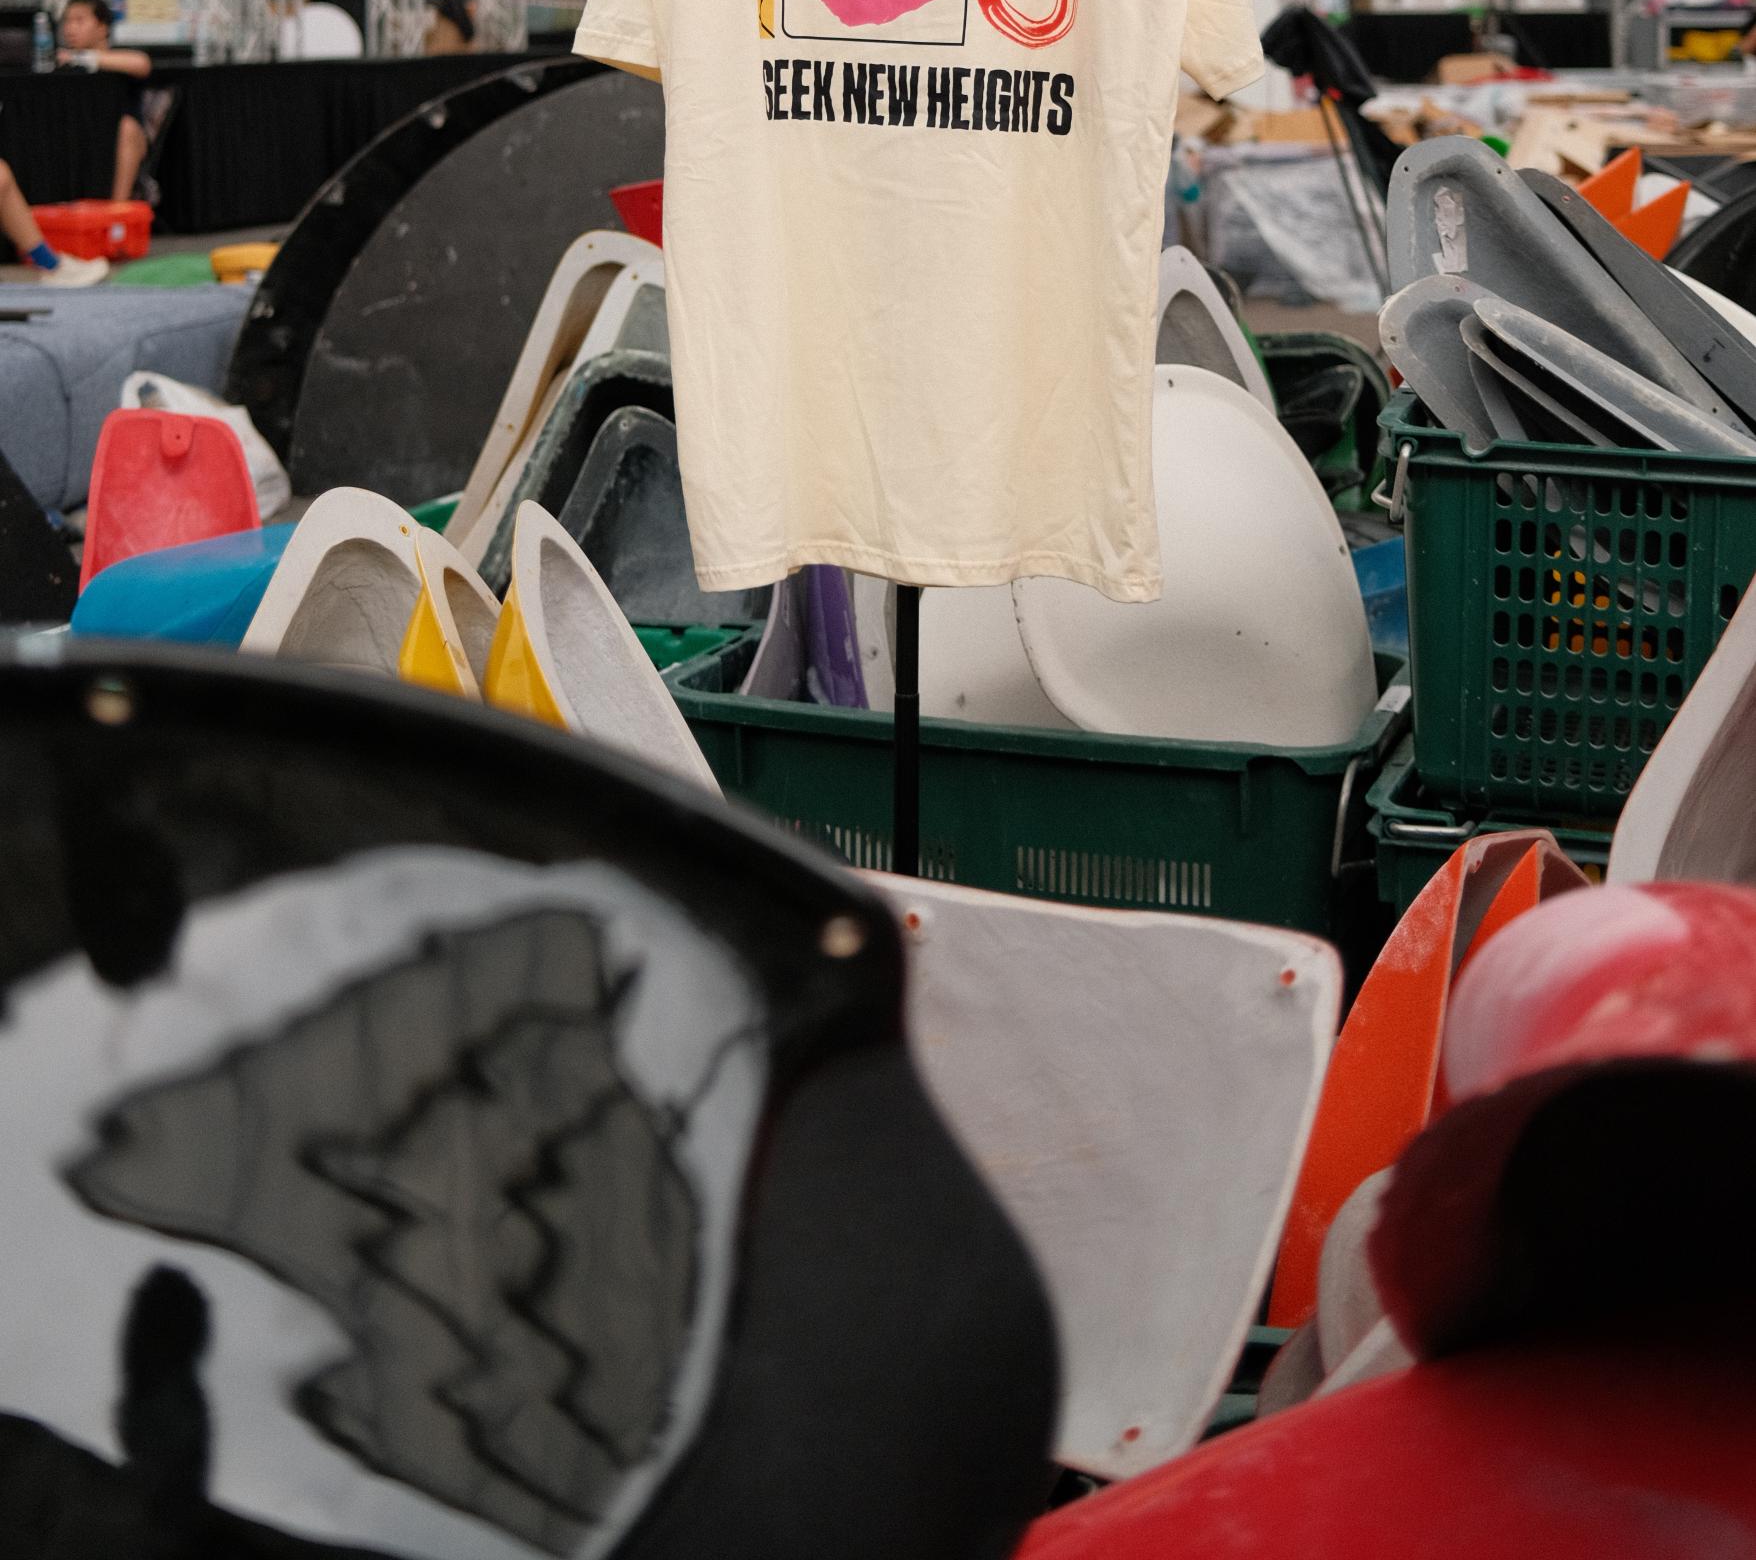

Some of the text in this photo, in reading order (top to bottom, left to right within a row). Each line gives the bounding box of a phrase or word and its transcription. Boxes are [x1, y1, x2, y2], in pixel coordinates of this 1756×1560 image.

[763, 59, 1075, 136] SEEK NEW HEIGHTS
